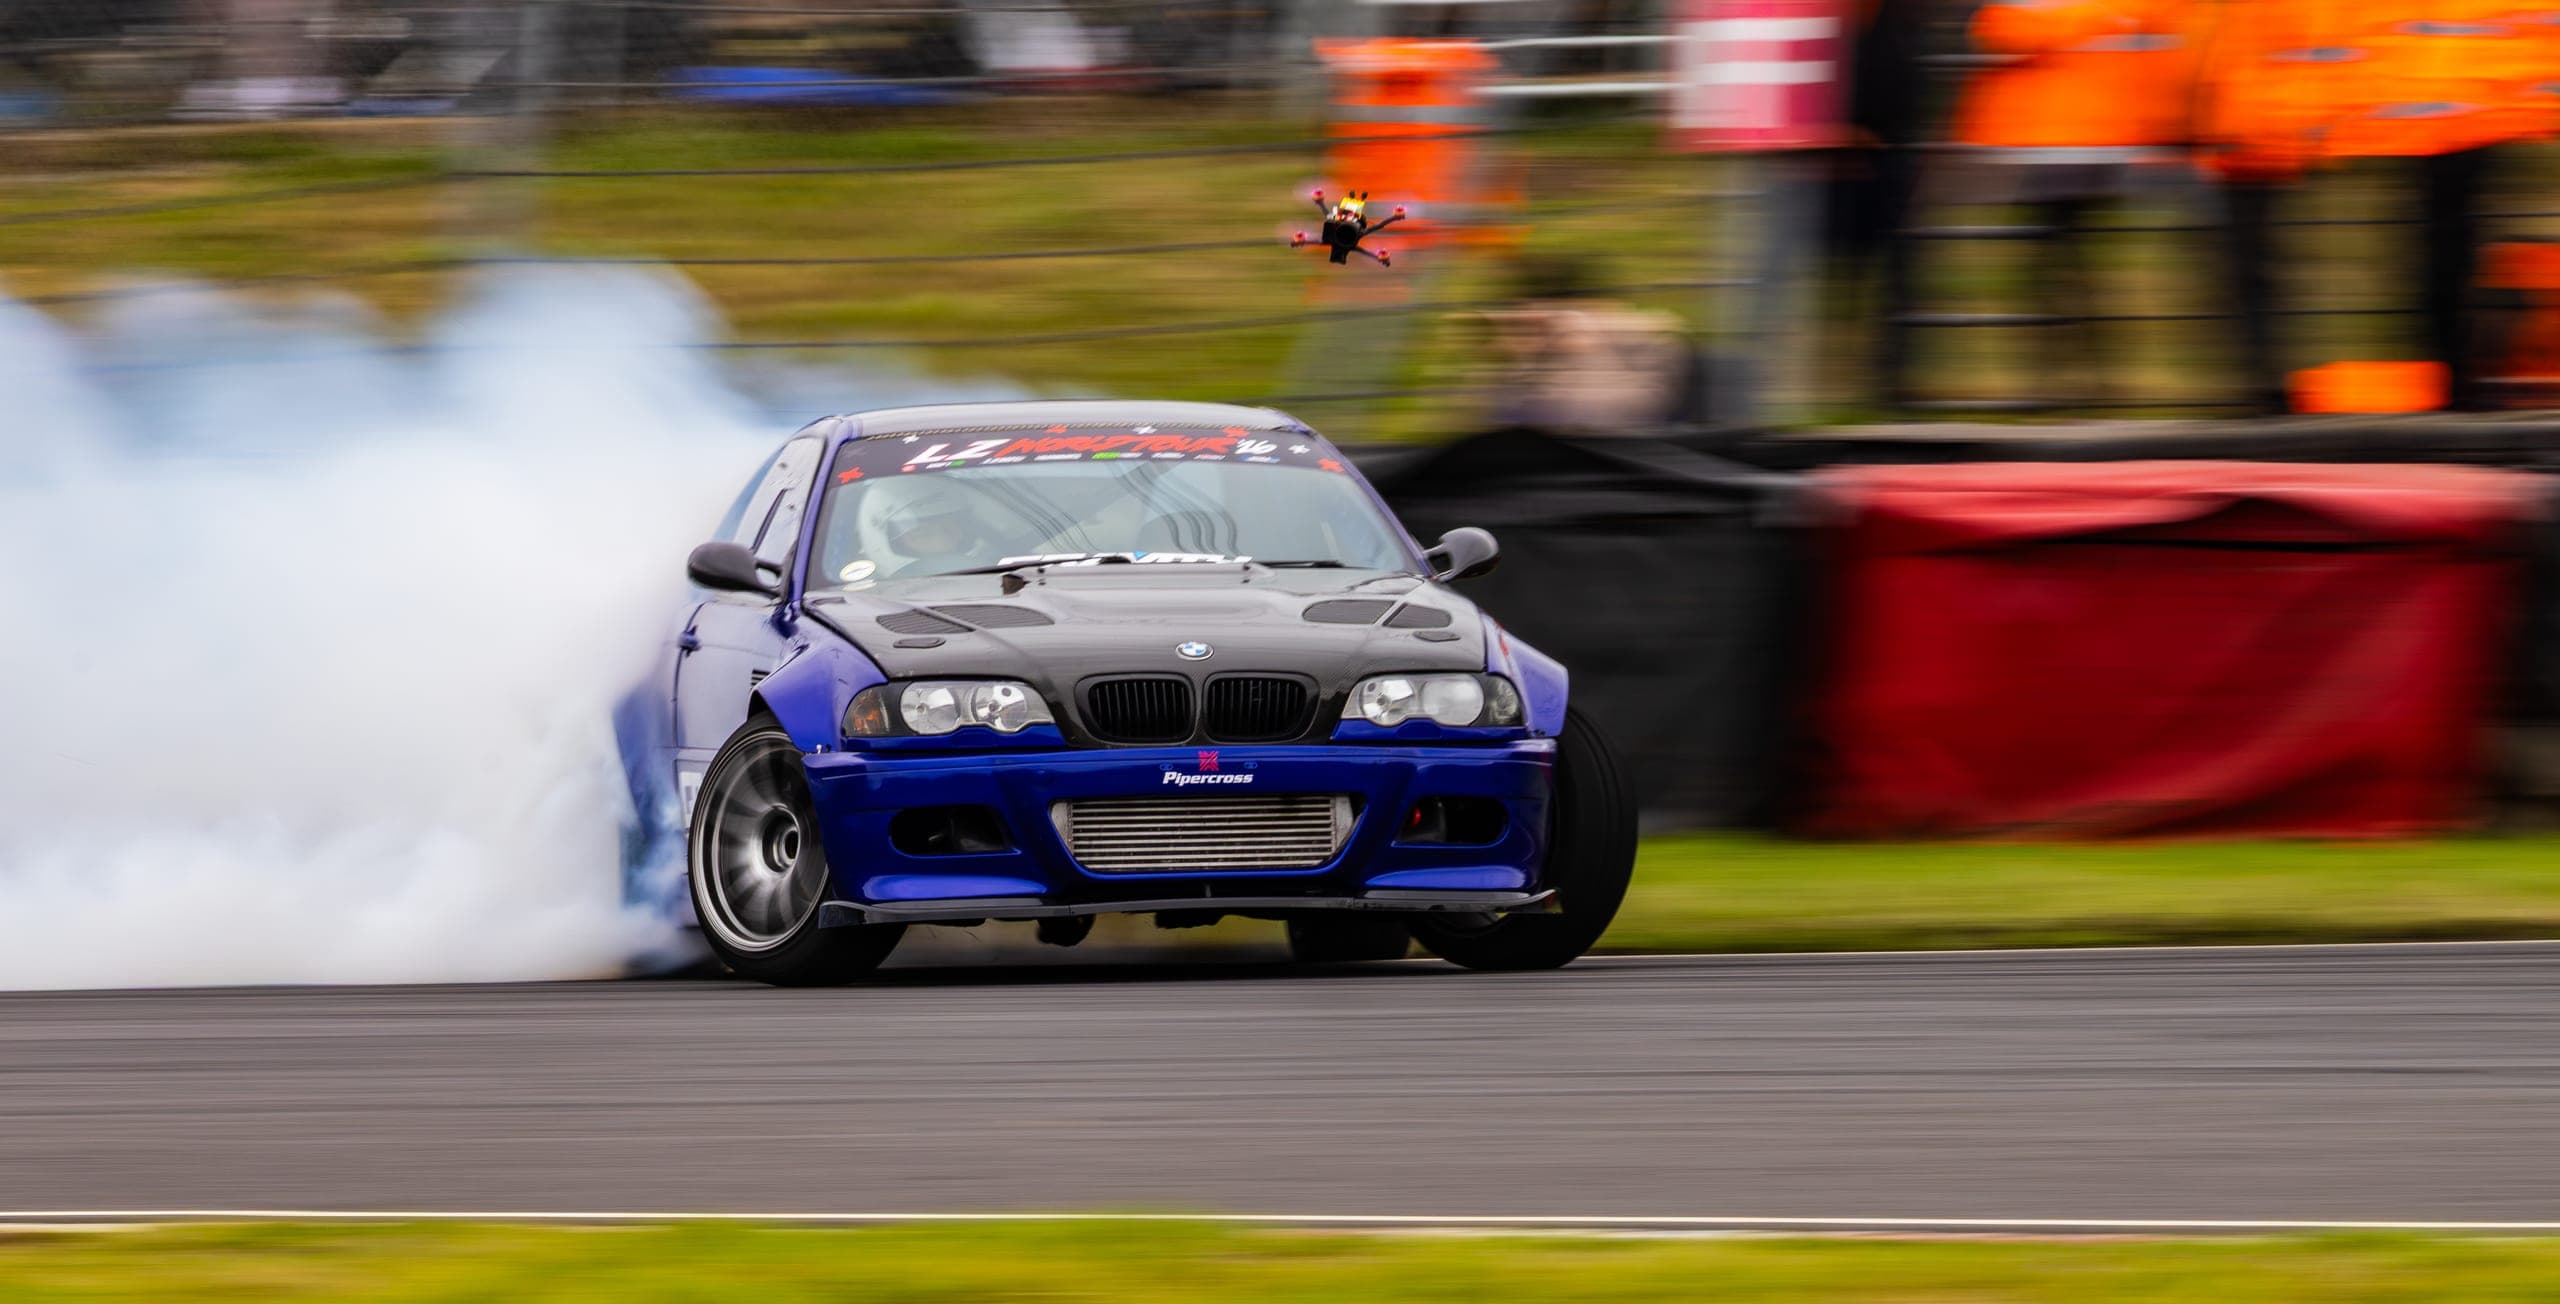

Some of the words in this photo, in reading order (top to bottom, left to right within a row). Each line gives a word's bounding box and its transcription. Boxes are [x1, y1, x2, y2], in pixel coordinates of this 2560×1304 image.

[903, 438, 1012, 465] LZ
[1131, 434, 1239, 453] TOUR
[1163, 771, 1254, 787] Pipercross
